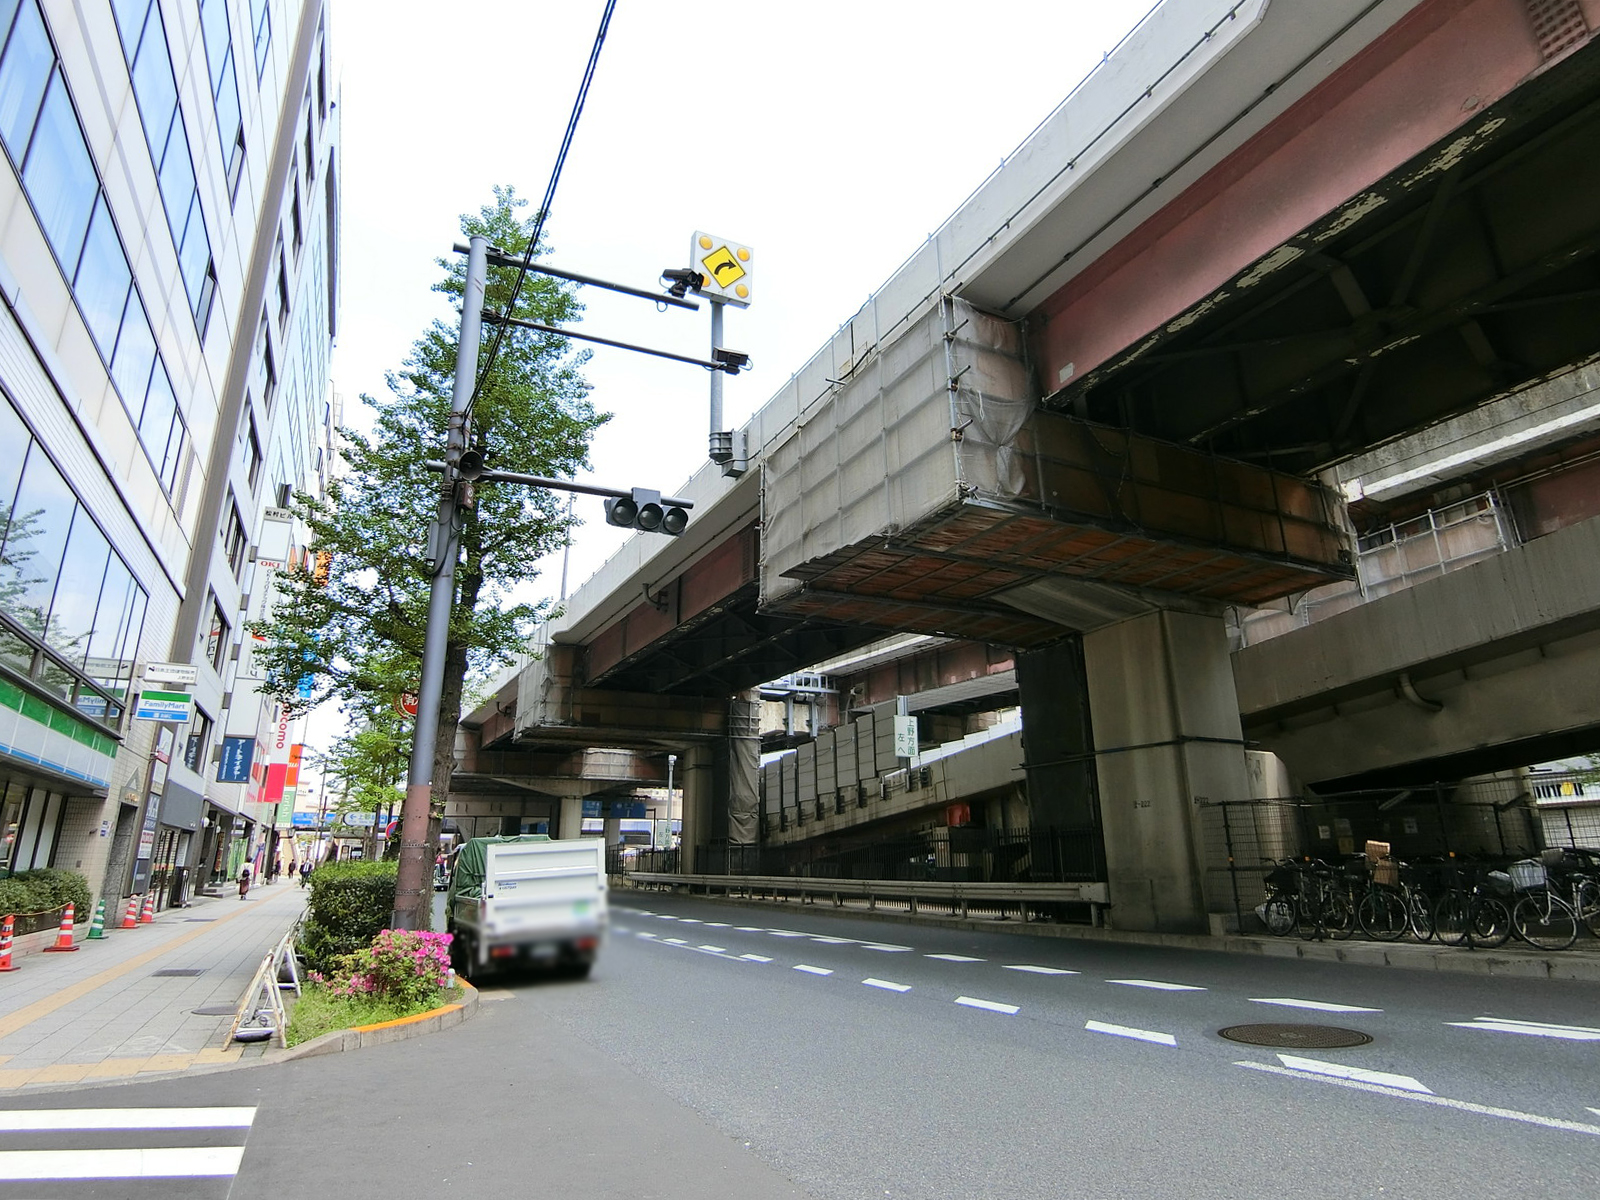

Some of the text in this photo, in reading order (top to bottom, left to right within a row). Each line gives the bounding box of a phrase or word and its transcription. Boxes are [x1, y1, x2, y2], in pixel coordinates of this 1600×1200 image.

[144, 700, 186, 710] FamilyMart
[897, 732, 906, 754] 左へ
[907, 718, 915, 755] 上野方面
